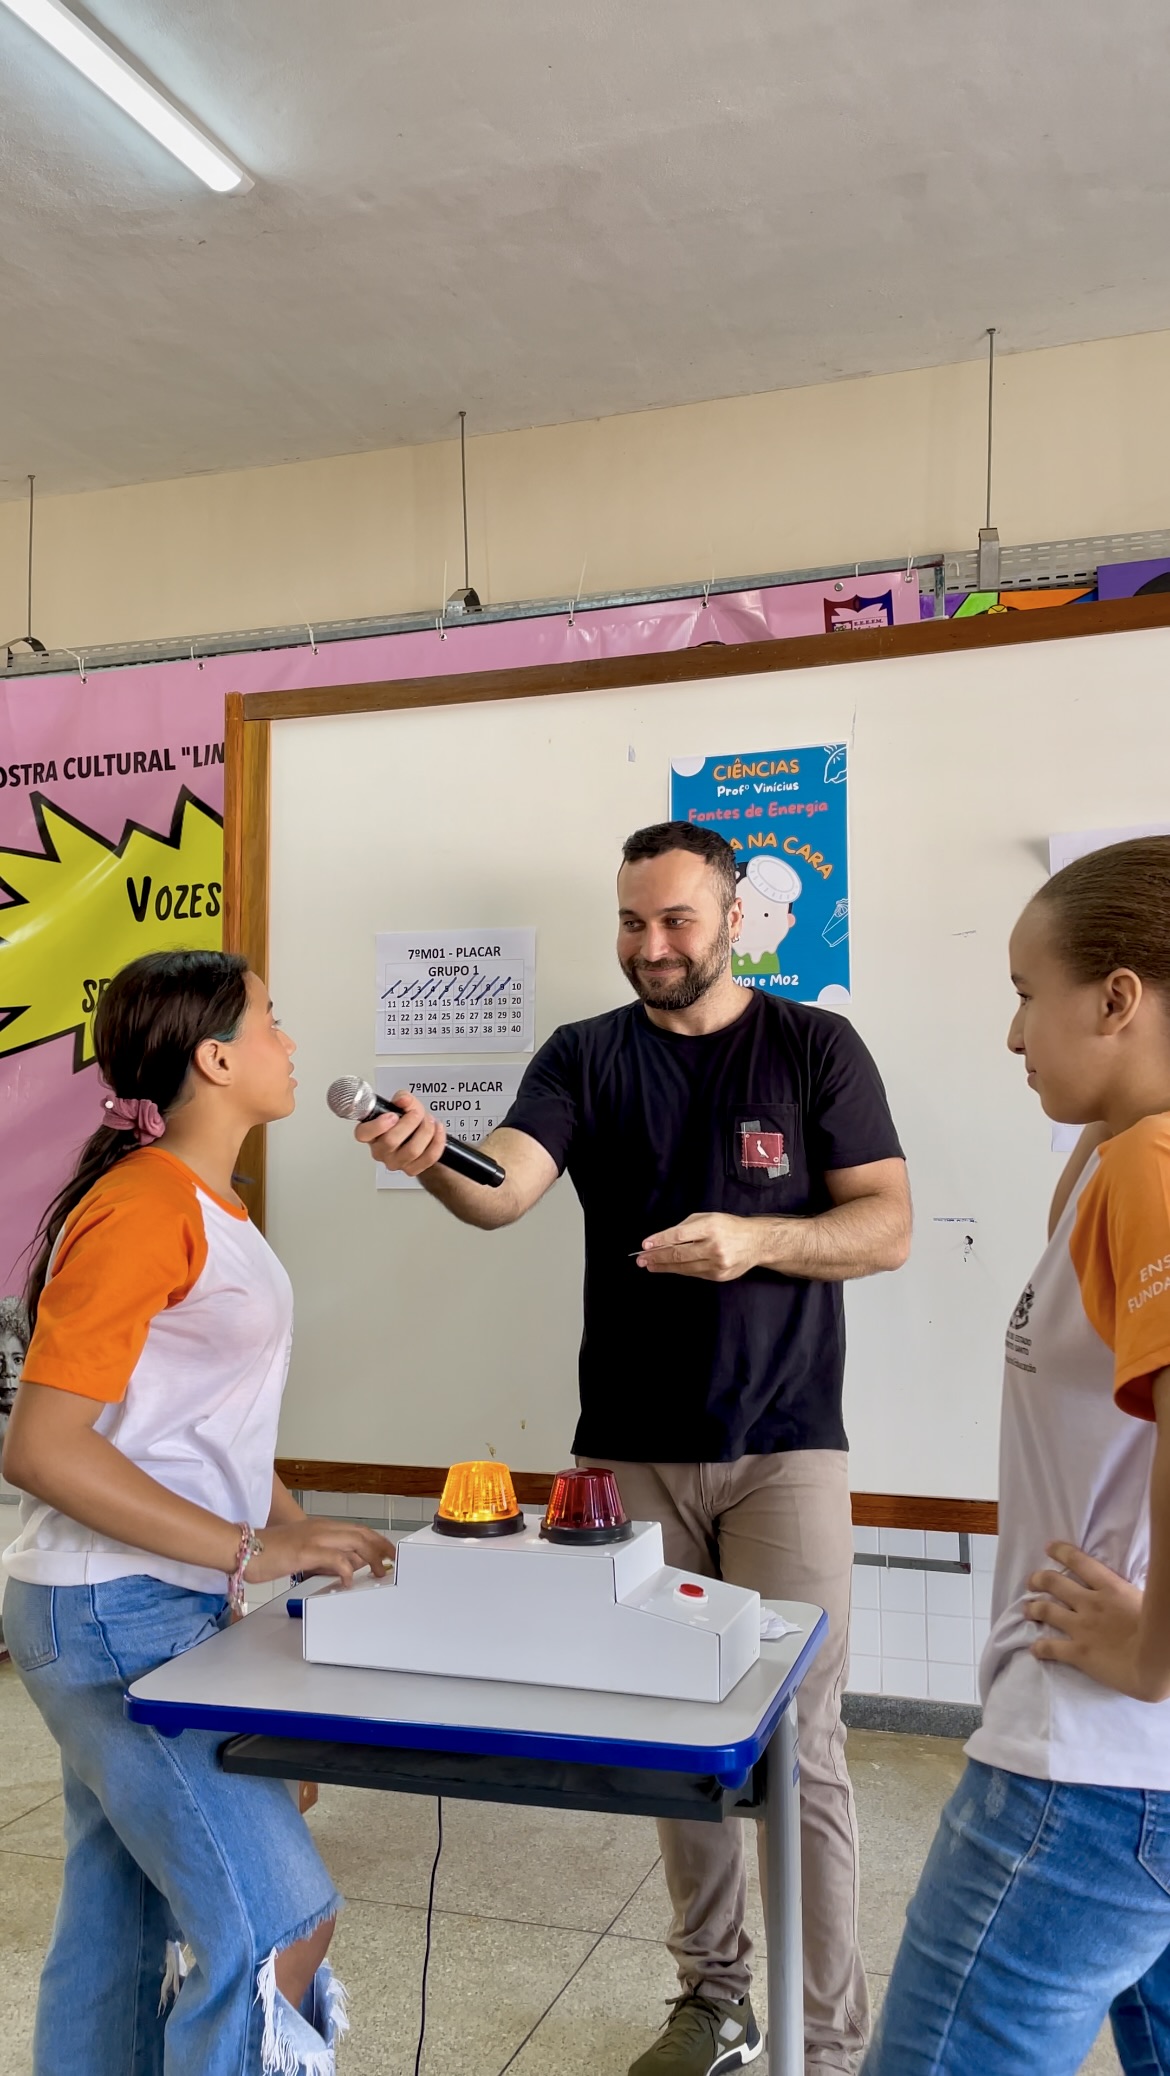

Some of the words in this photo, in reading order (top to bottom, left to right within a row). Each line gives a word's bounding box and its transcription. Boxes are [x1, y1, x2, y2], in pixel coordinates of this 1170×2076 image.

[63, 748, 176, 780] CULTURAL
[713, 758, 799, 781] CIÊNCIAS
[753, 782, 799, 794] Vinícius
[688, 808, 740, 822] Fontes
[745, 804, 763, 818] de
[768, 800, 828, 818] Energia
[748, 832, 777, 849] NA
[783, 837, 833, 880] CARA
[456, 946, 501, 958] PLACAR
[428, 965, 470, 977] GRUPO
[473, 965, 479, 975] 1
[759, 978, 766, 986] e
[769, 974, 799, 987] M02
[414, 1013, 423, 1021] 23
[455, 1012, 465, 1020] 26
[414, 1027, 423, 1035] 33
[458, 1081, 503, 1093] PLACAR
[430, 1100, 471, 1111] GRUPO
[475, 1100, 481, 1111] 1
[446, 1119, 451, 1127] 5
[460, 1119, 465, 1127] 6
[474, 1119, 479, 1127] 7
[458, 1133, 467, 1141] 16
[471, 1133, 481, 1141] 17
